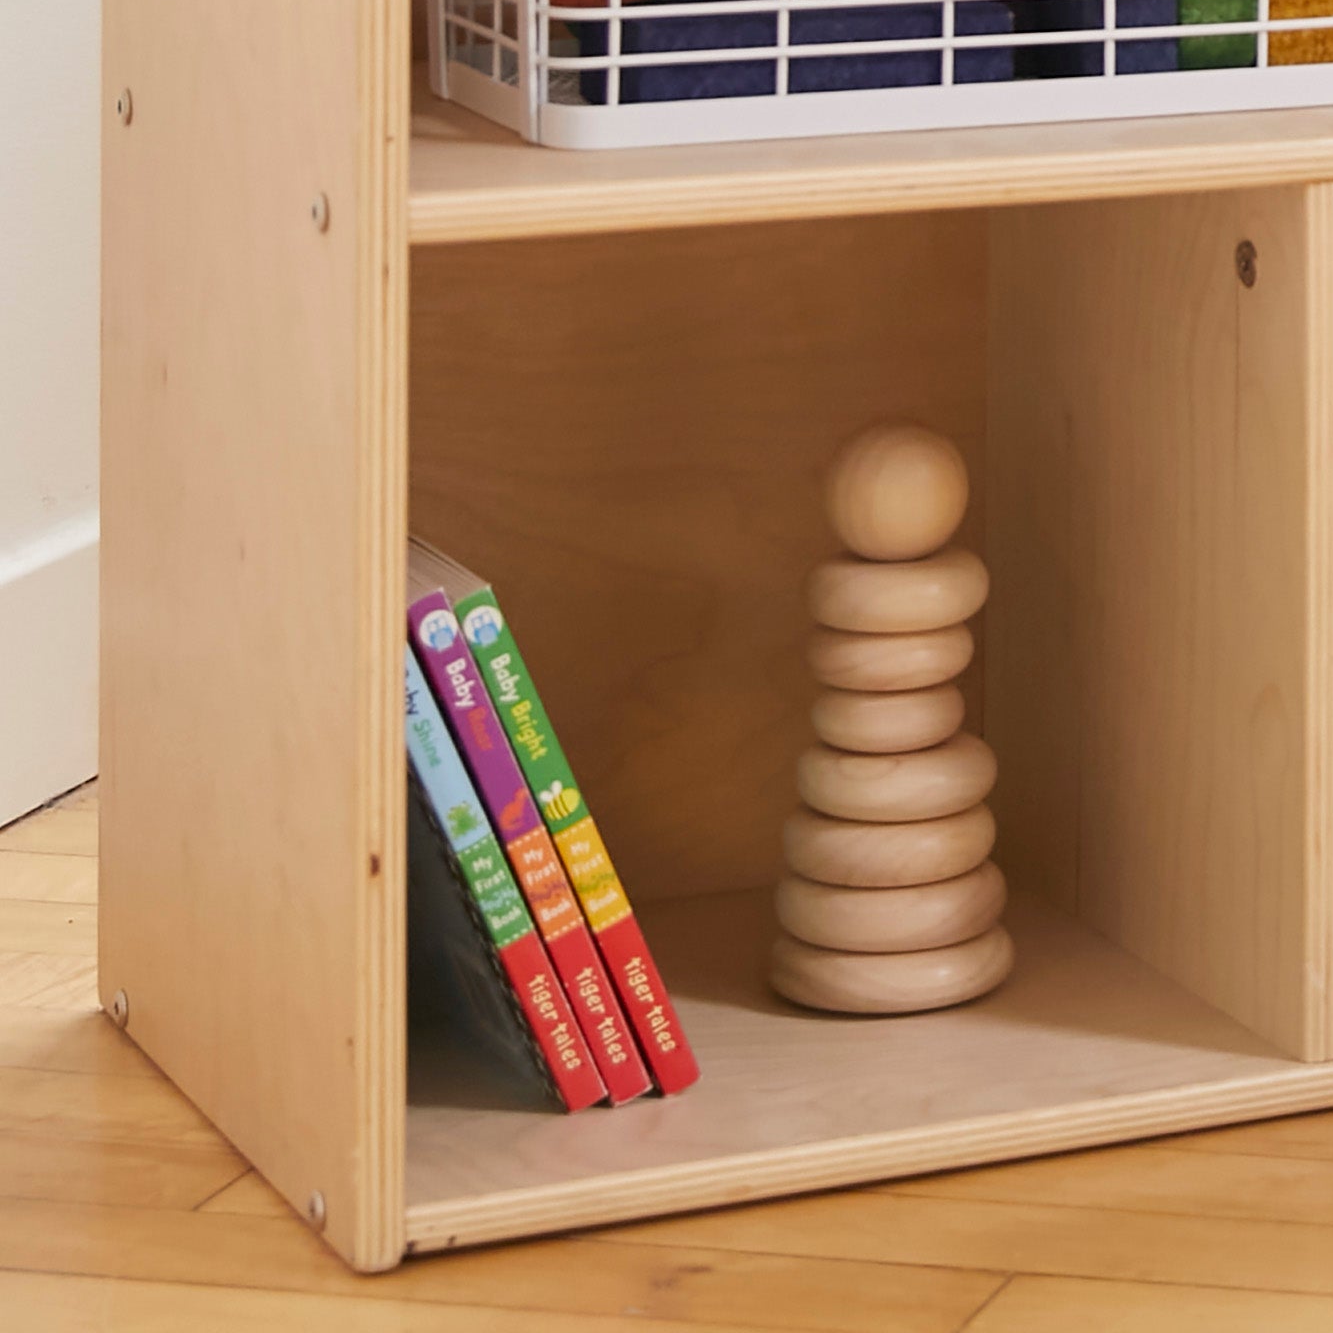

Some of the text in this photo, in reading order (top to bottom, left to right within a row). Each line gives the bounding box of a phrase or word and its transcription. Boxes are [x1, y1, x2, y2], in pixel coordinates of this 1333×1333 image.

[446, 658, 475, 707] Baby
[490, 653, 548, 761] Baby Bright
[414, 719, 441, 768] Shine
[472, 856, 493, 873] My
[523, 847, 544, 864] My
[569, 841, 590, 855] My
[572, 853, 603, 876] First
[474, 869, 506, 893] First
[526, 862, 557, 886] First
[528, 974, 581, 1070] tiger tales
[576, 967, 627, 1064] tiger tales
[624, 956, 676, 1052] tiger tales
